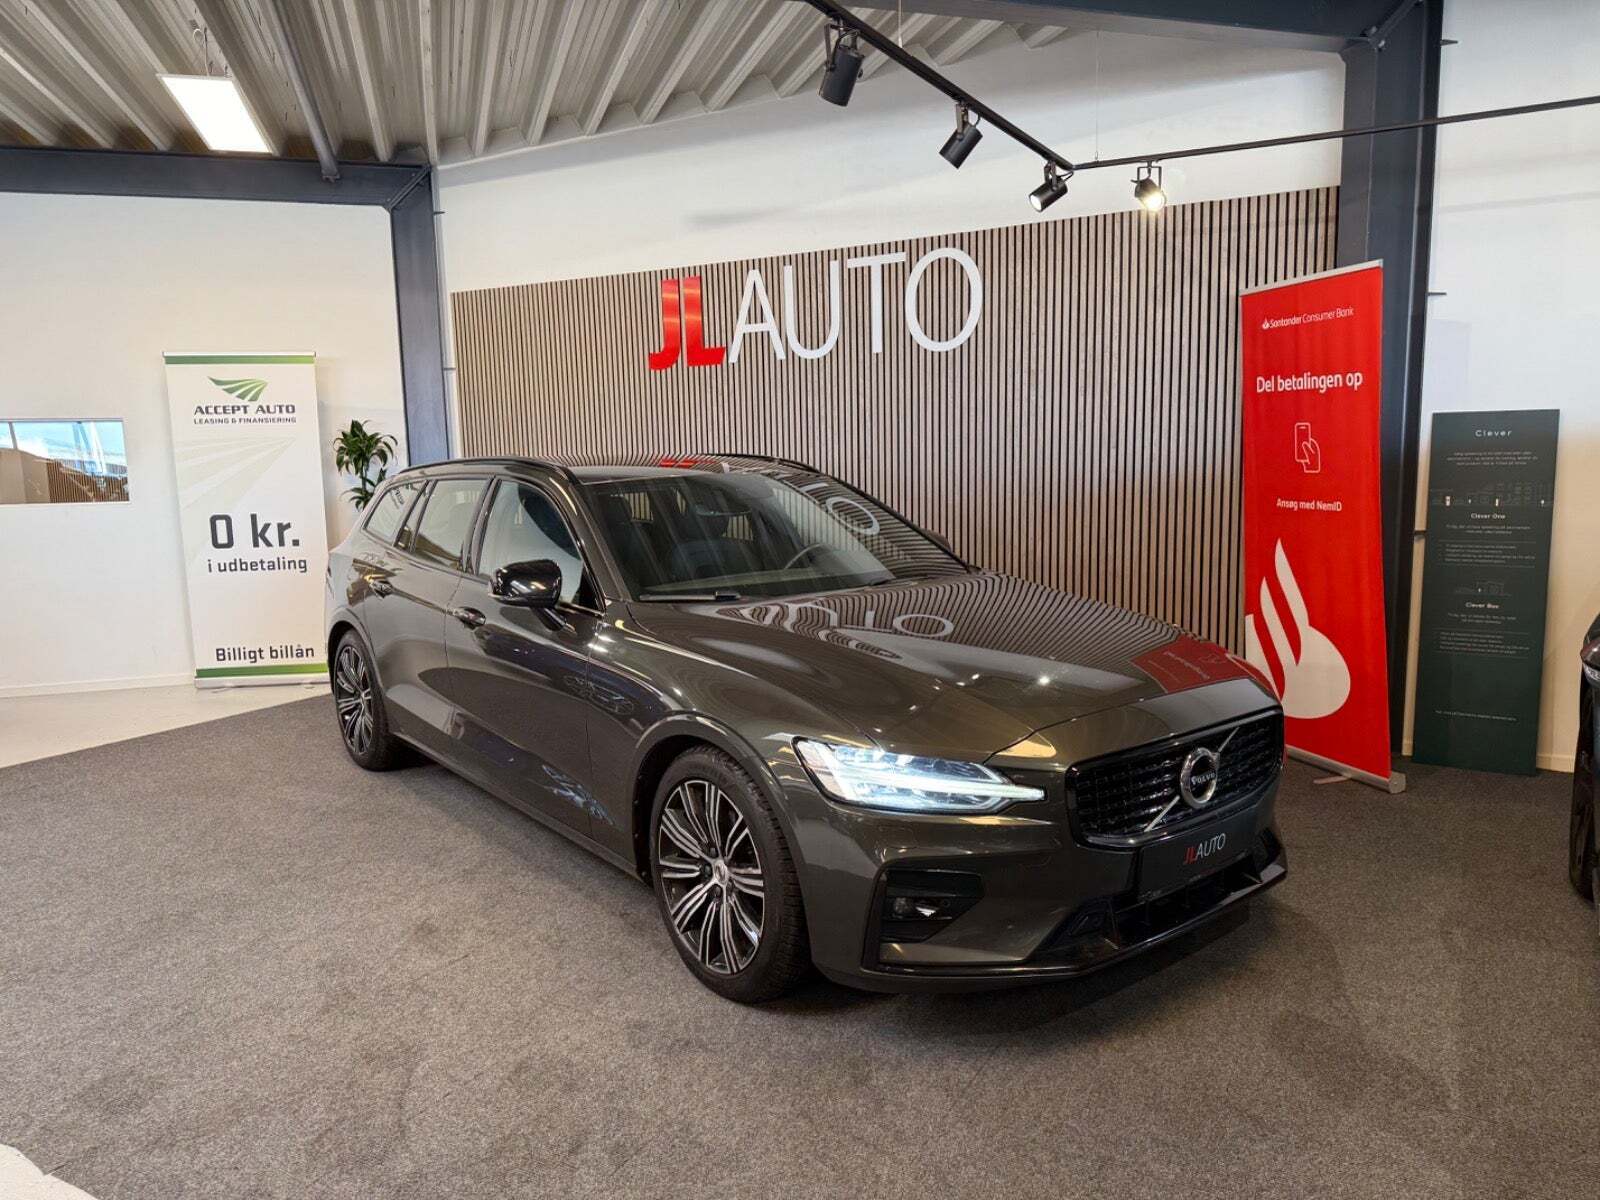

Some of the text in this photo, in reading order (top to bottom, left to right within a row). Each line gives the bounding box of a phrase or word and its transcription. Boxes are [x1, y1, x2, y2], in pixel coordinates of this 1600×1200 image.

[1269, 315, 1301, 328] Santander
[1336, 306, 1354, 318] Bank
[1256, 371, 1363, 393] Del betalingen op
[194, 404, 296, 415] ACCEPT AUTO
[194, 417, 229, 425] LEASING
[239, 416, 296, 424] FINANSIERING
[1475, 429, 1513, 437] Clever
[1276, 498, 1342, 512] Ansøg med NemID
[209, 513, 300, 549] 0 kr.
[207, 556, 307, 573] i udbetaling
[215, 644, 315, 664] Billigt billån
[1191, 771, 1216, 785] VOLVO
